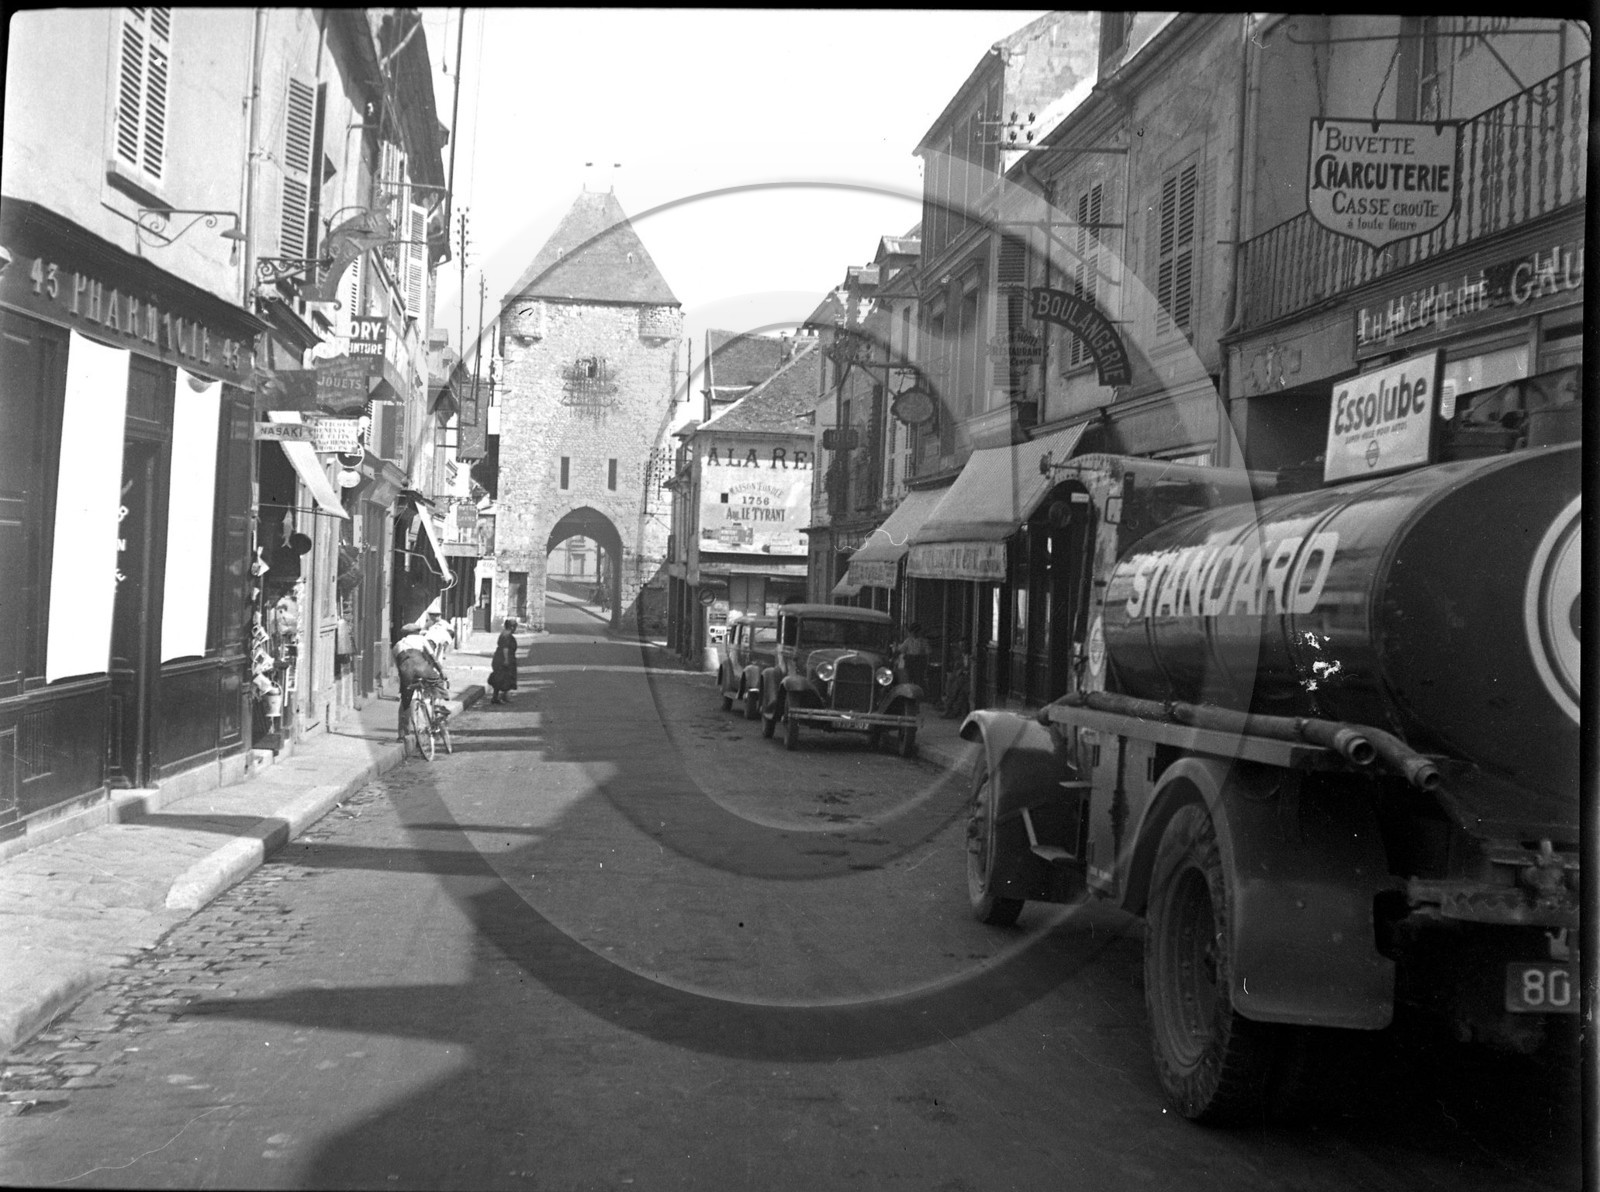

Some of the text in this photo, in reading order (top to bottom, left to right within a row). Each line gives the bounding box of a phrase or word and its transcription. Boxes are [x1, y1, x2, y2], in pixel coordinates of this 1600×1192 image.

[1325, 127, 1415, 155] BUVETTE
[1312, 154, 1450, 192] CHARCUTERIE
[1332, 191, 1390, 216] CASSE
[31, 257, 240, 369] 43 PHARMACIE 43
[1358, 276, 1489, 345] CHARCUTERIE
[1037, 291, 1126, 382] BOULANGERIE
[316, 375, 362, 390] JOUETS
[1335, 373, 1427, 436] Essolube
[260, 426, 303, 438] NASAKI
[742, 496, 770, 506] 1756
[742, 507, 751, 520] LE
[752, 506, 786, 522] TYRANT
[1126, 531, 1340, 618] STANDARD
